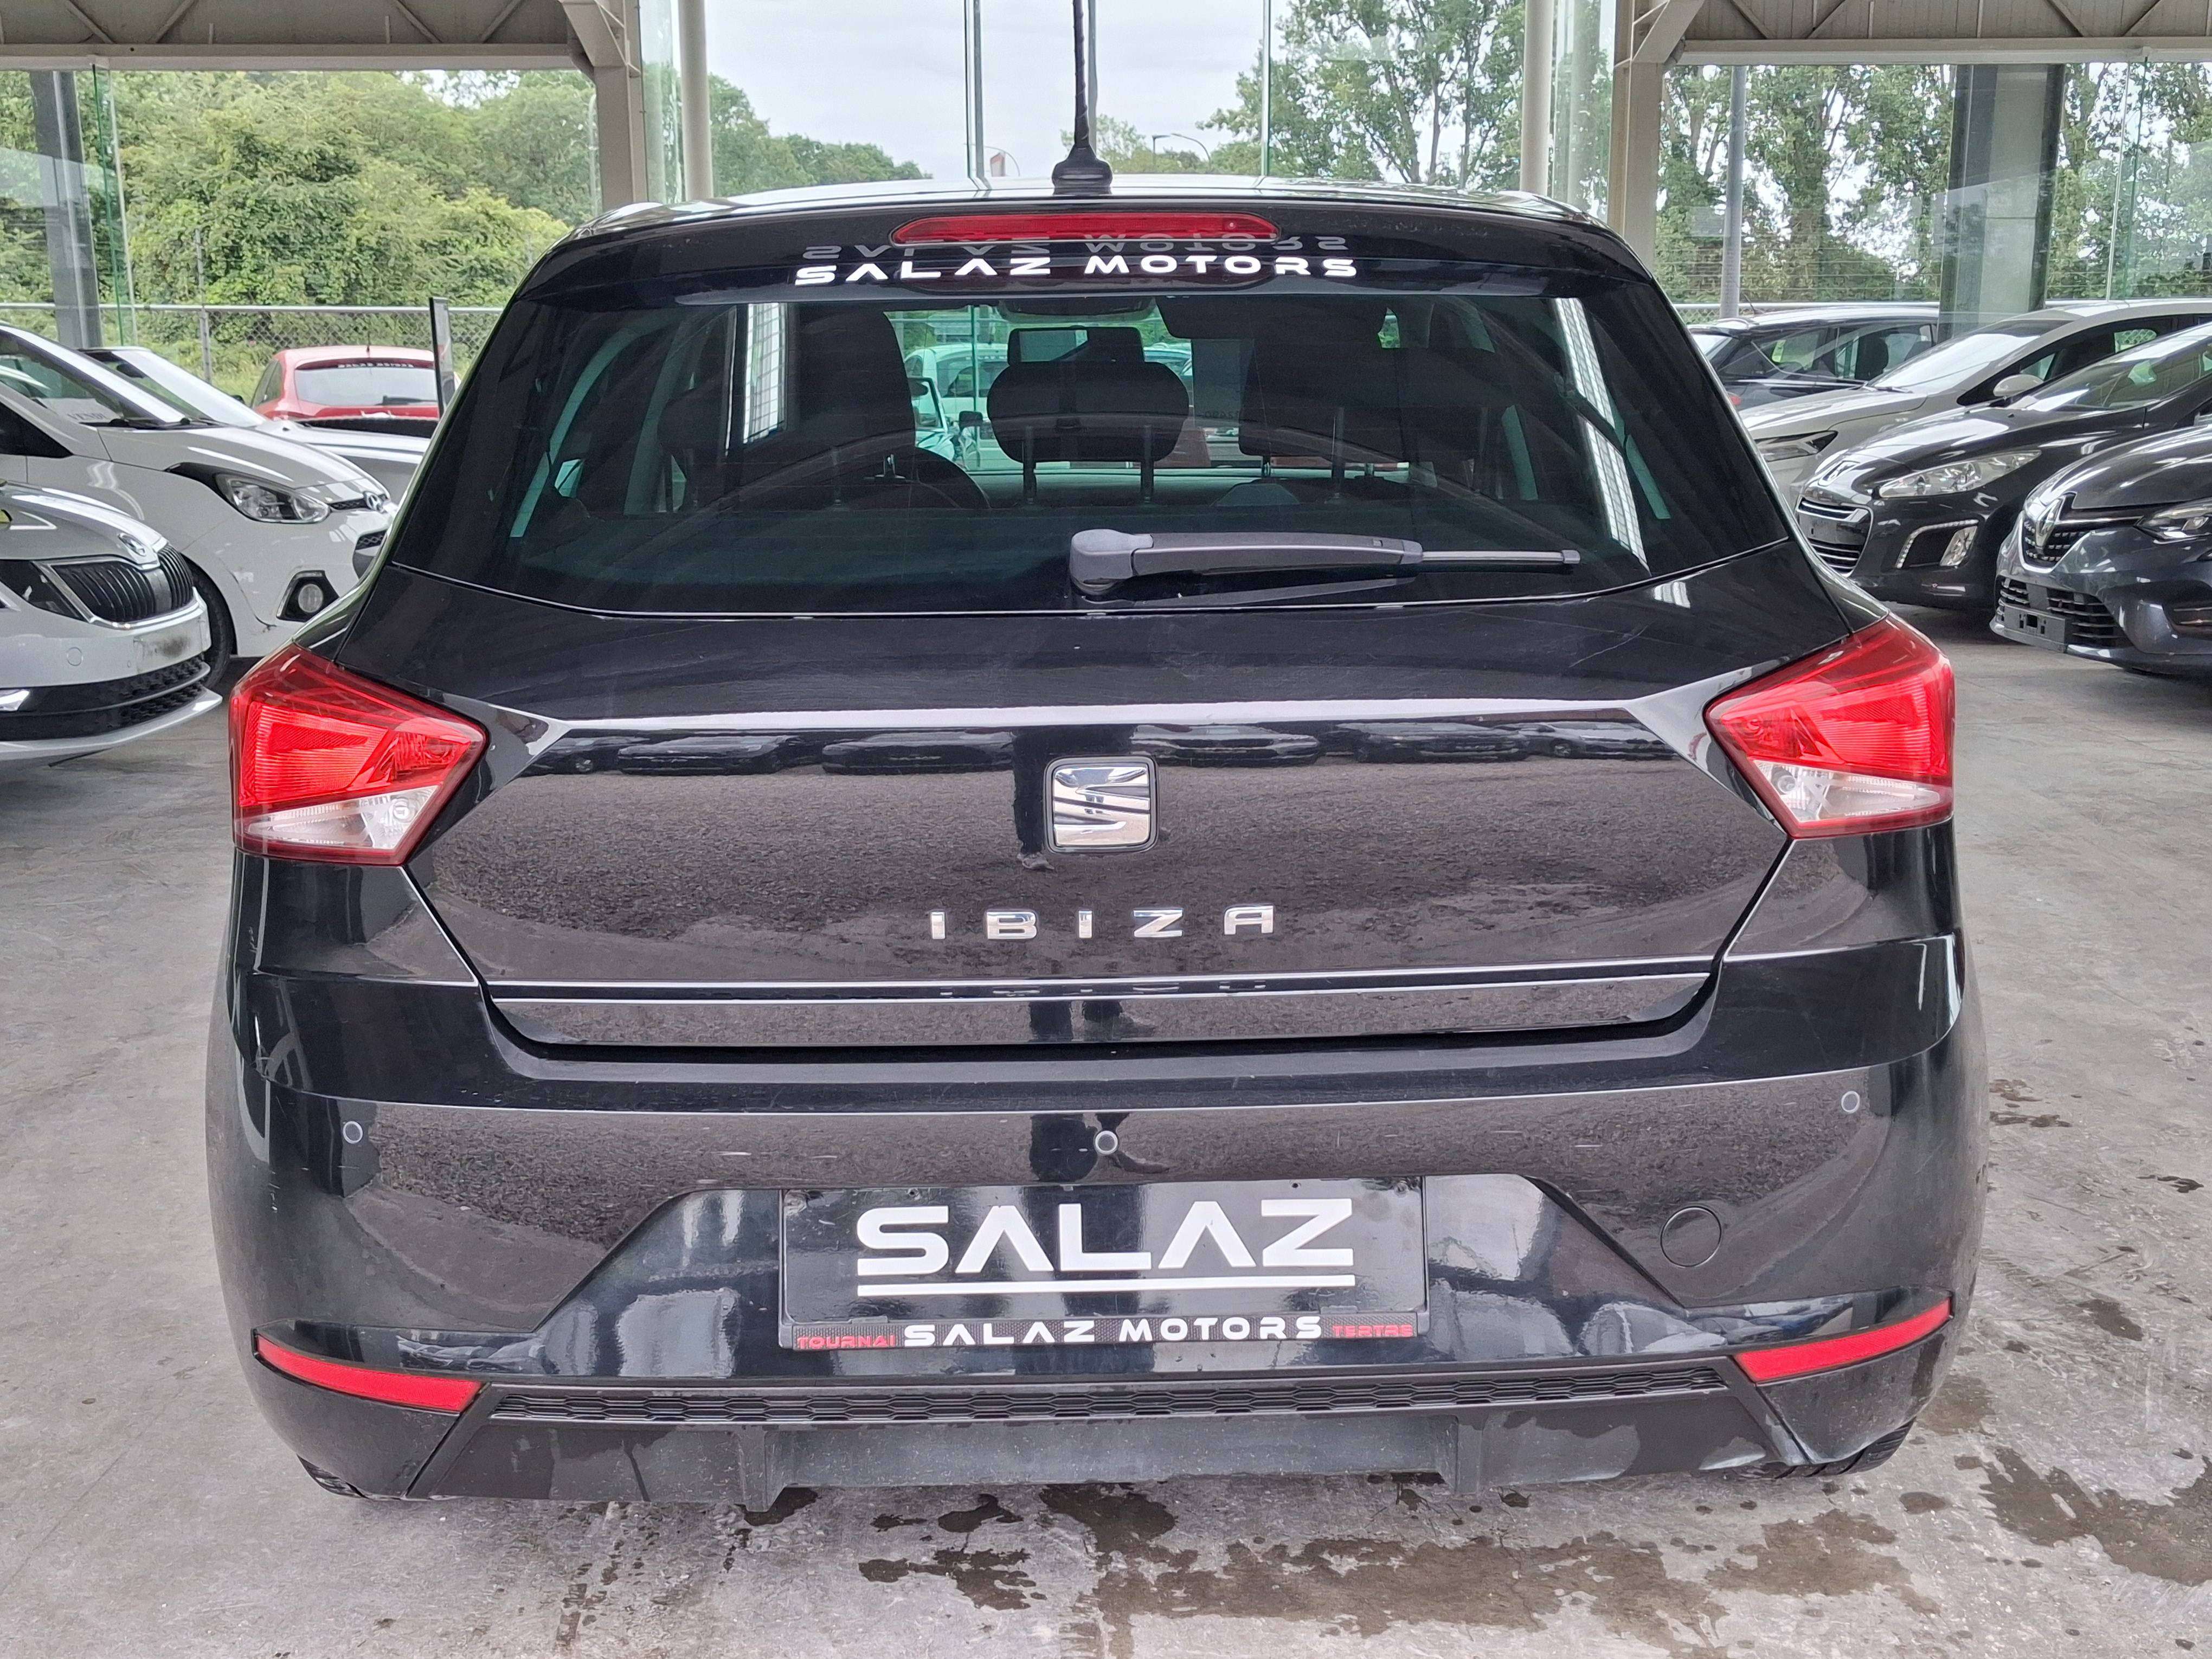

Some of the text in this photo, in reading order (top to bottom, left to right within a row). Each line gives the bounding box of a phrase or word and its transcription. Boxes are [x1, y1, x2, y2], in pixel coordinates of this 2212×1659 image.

[794, 254, 1357, 286] SALAZ MOTORS
[929, 904, 1275, 940] IBIZA
[856, 1198, 1354, 1277] SALAZ
[797, 1335, 895, 1349] TOURNAI
[904, 1320, 1095, 1347] SALAZ
[1118, 1316, 1322, 1342] MOTORS
